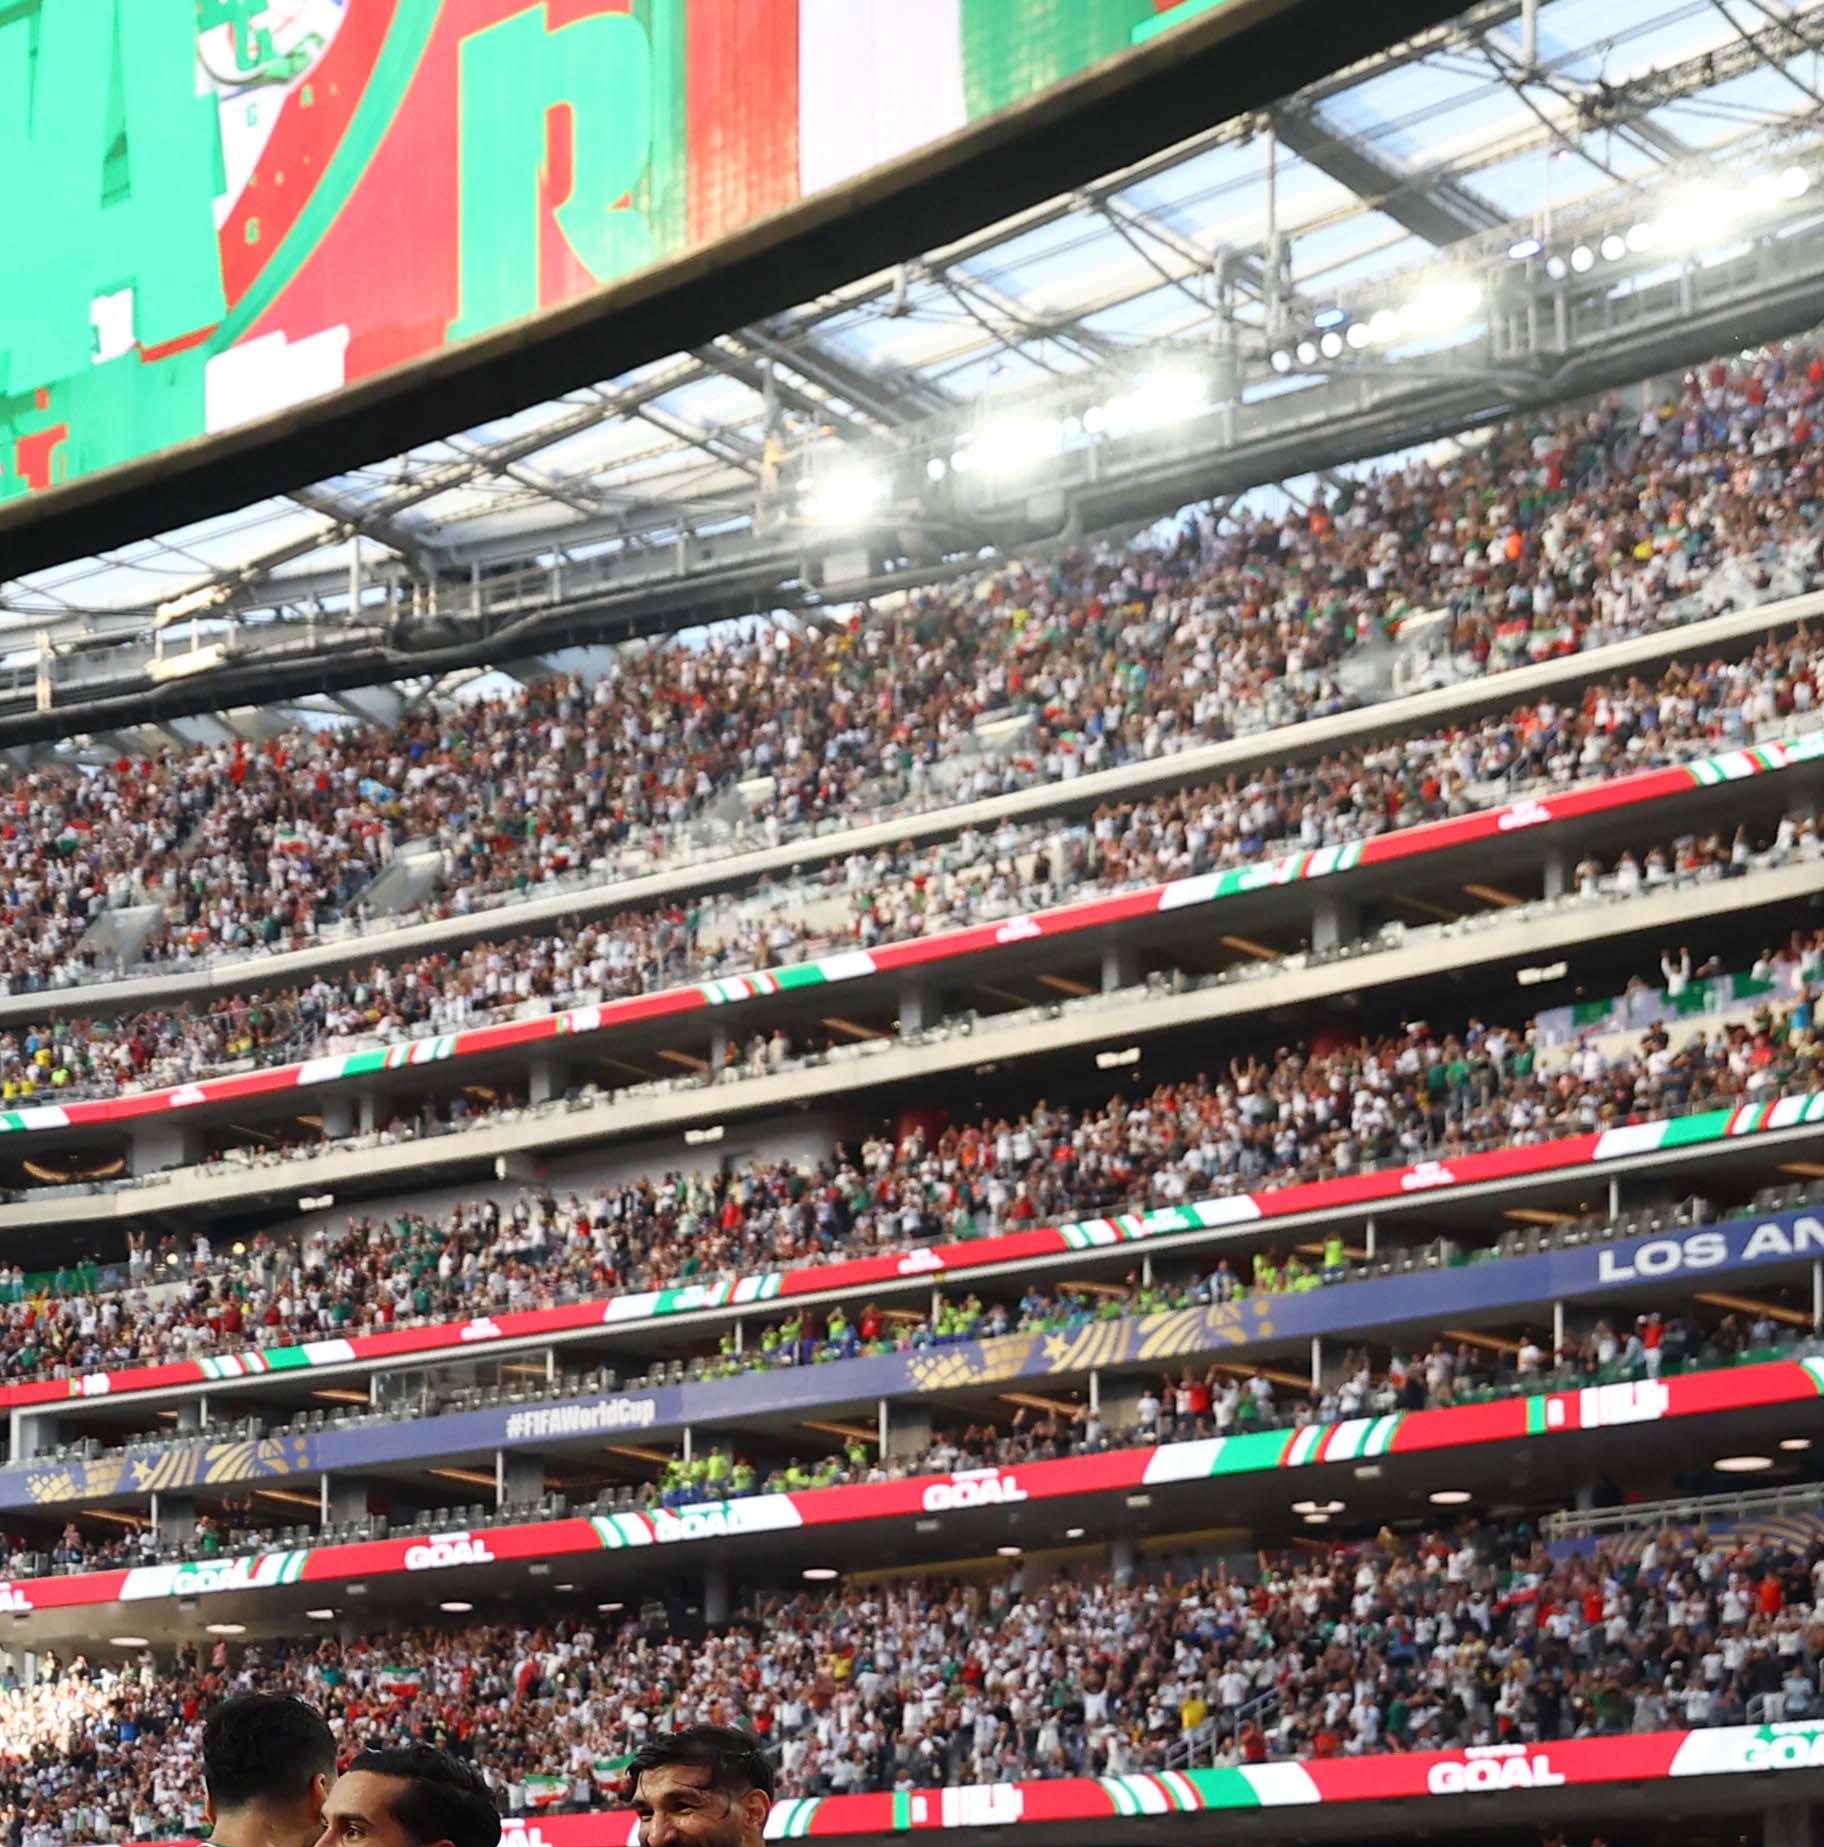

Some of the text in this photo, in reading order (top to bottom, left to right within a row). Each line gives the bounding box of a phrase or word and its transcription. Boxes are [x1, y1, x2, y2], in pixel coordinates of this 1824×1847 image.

[1598, 1214, 1824, 1283] LOS AN
[505, 1397, 656, 1440] #FIFAWorldCup
[923, 1475, 1028, 1511] GOAL
[405, 1538, 495, 1571] GOAL
[1427, 1754, 1566, 1794] GOAL
